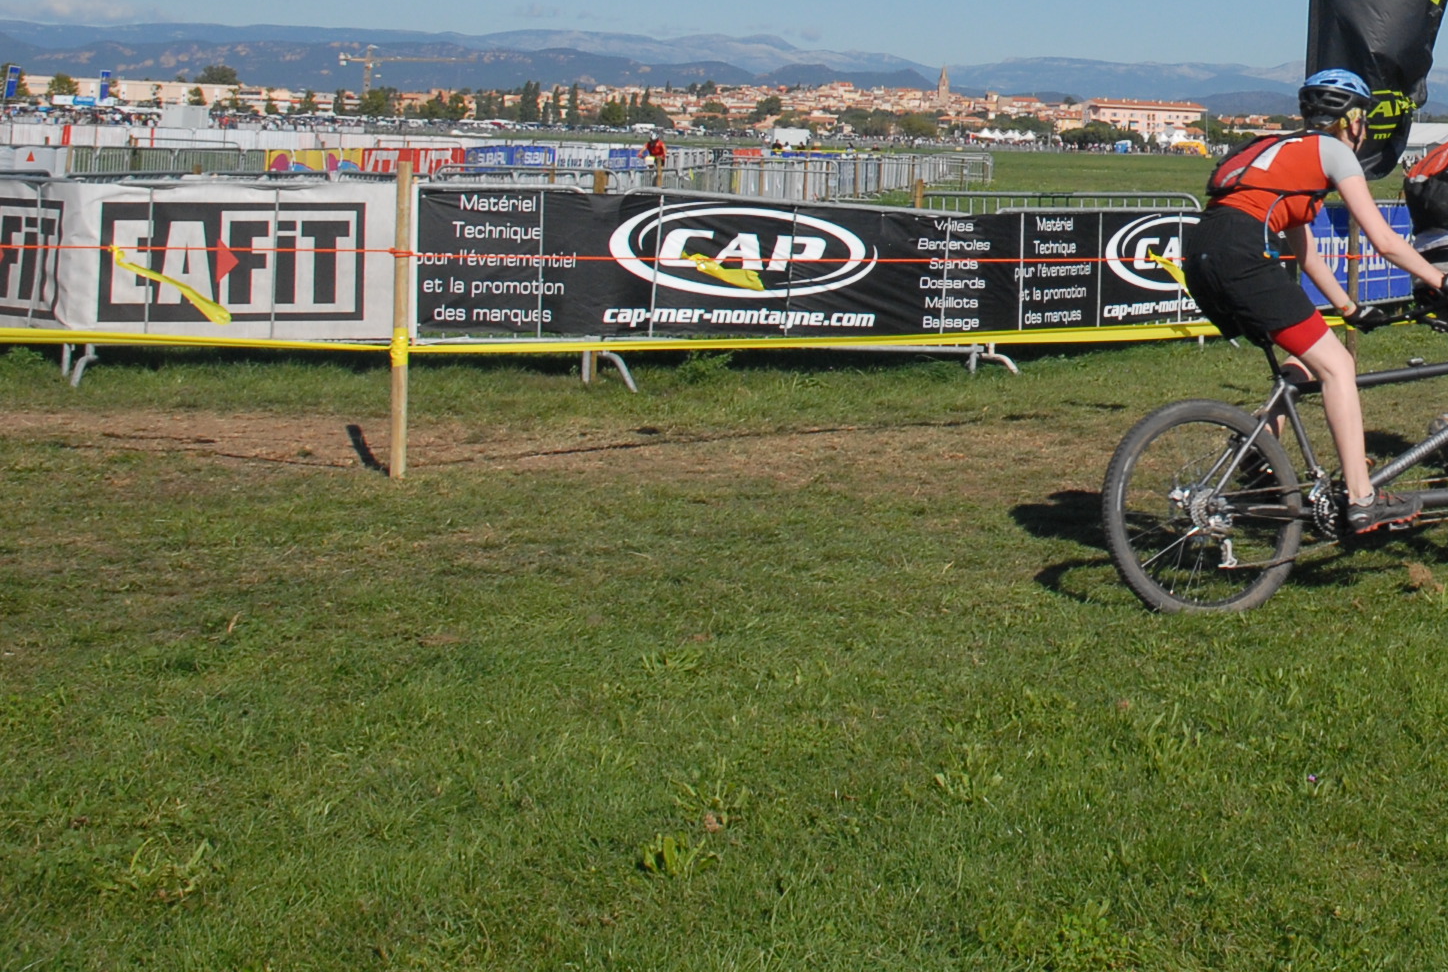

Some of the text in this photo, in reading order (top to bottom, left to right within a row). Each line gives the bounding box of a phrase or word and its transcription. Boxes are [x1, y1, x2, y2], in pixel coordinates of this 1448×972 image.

[460, 194, 536, 212] Matériel
[452, 221, 542, 243] Technique
[1036, 216, 1074, 232] Matériel
[659, 228, 826, 272] CAP
[917, 238, 991, 251] Banderoles
[1033, 240, 1077, 257] Technique
[1133, 236, 1182, 270] CA
[0, 215, 57, 302] FiT
[929, 258, 979, 270] Stands
[1014, 267, 1035, 281] pur
[423, 277, 564, 298] et la promotion
[919, 277, 986, 289] Dossards
[925, 296, 979, 309] Maillots
[1020, 285, 1087, 303] et la promotion
[434, 304, 552, 325] des marques
[603, 307, 876, 328] cap-mer-montagne.com
[1025, 309, 1082, 325] des marques
[922, 316, 979, 331] Baisage
